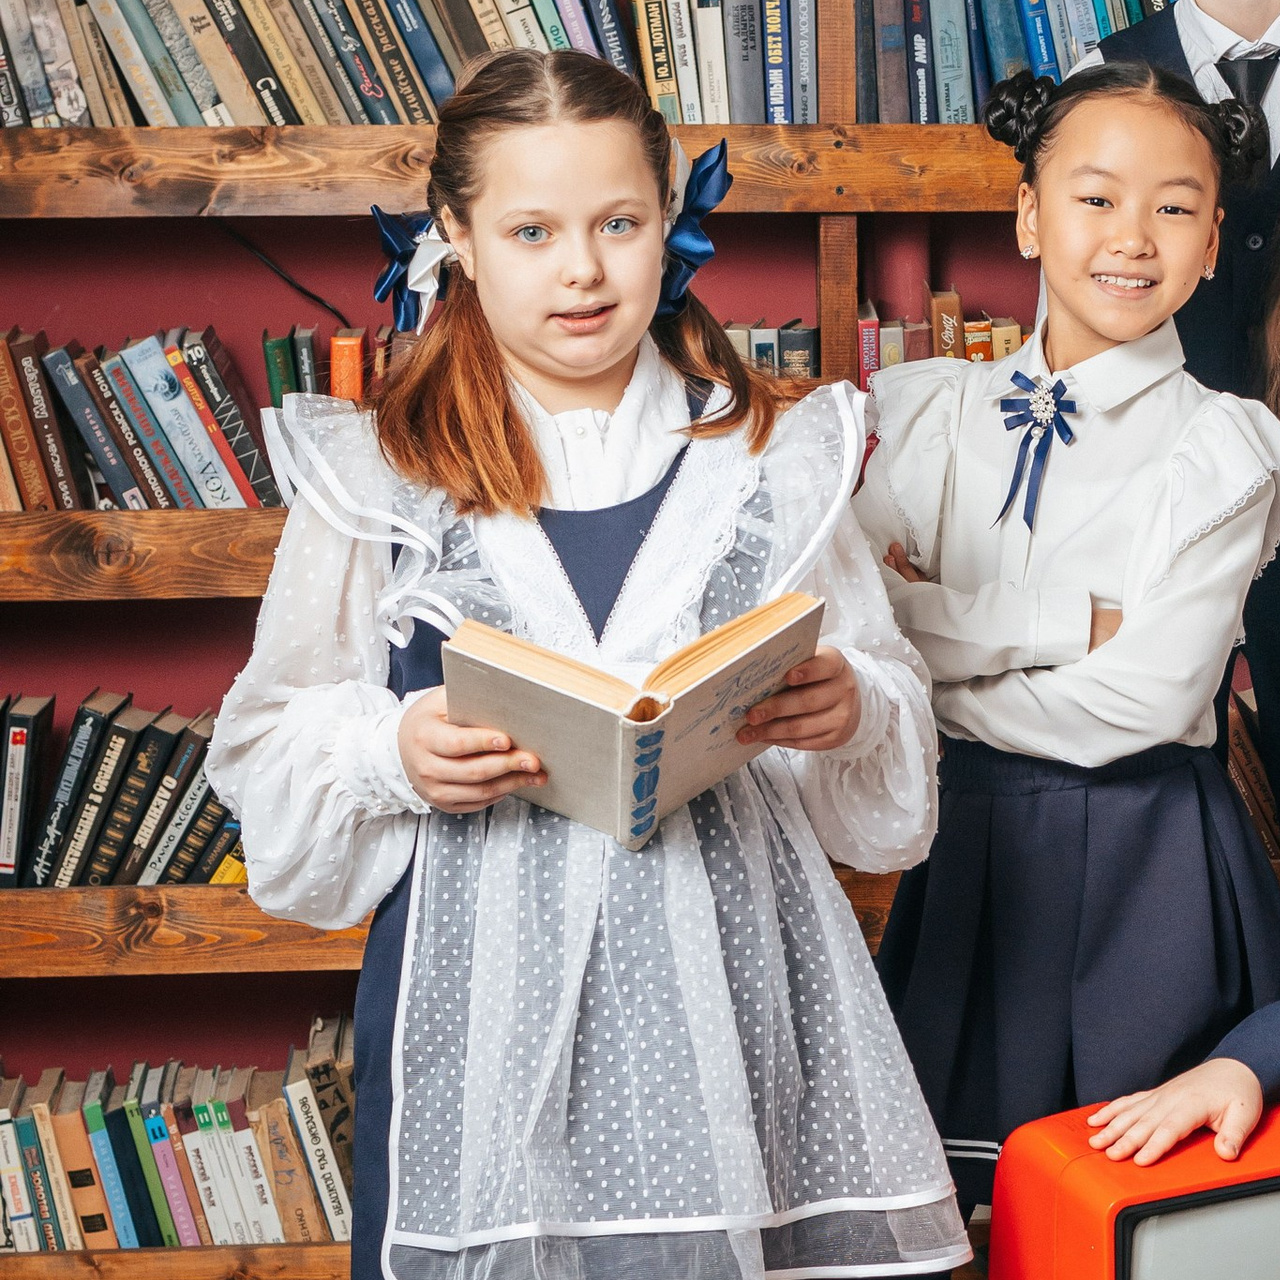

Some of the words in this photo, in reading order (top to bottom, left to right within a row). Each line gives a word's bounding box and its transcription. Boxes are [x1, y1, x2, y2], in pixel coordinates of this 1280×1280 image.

[647, 2, 665, 47] ЛОТМАН
[653, 49, 667, 62] М.
[655, 63, 669, 77] Ю.
[766, 36, 782, 63] ОБЕТ
[798, 39, 810, 82] ЗАБЫТАЯ
[385, 55, 427, 127] ралийские
[769, 68, 784, 105] ИЛЬИН
[863, 328, 871, 370] СВОИМИ
[870, 328, 878, 369] РУКАМИ
[18, 355, 49, 419] Мастера
[89, 367, 113, 398] ВОИН
[181, 376, 205, 411] DEUTSCH
[197, 363, 222, 403] География
[83, 405, 107, 442] СМЕРТЬ
[107, 397, 139, 447] РОЗЫСКА
[43, 432, 64, 478] КРАСАВИН
[102, 445, 118, 466] МОЯ
[131, 445, 170, 510] УГОЛОВНОГО
[160, 774, 177, 790] О
[132, 787, 171, 849] ЛЕНИНЕ
[53, 802, 98, 889] ПРЕСТУПЛЕНИЕ
[86, 791, 102, 803] В
[296, 1095, 321, 1145] ОКЕАНОВ
[318, 1170, 343, 1217] ВЕЛИКИЙ
